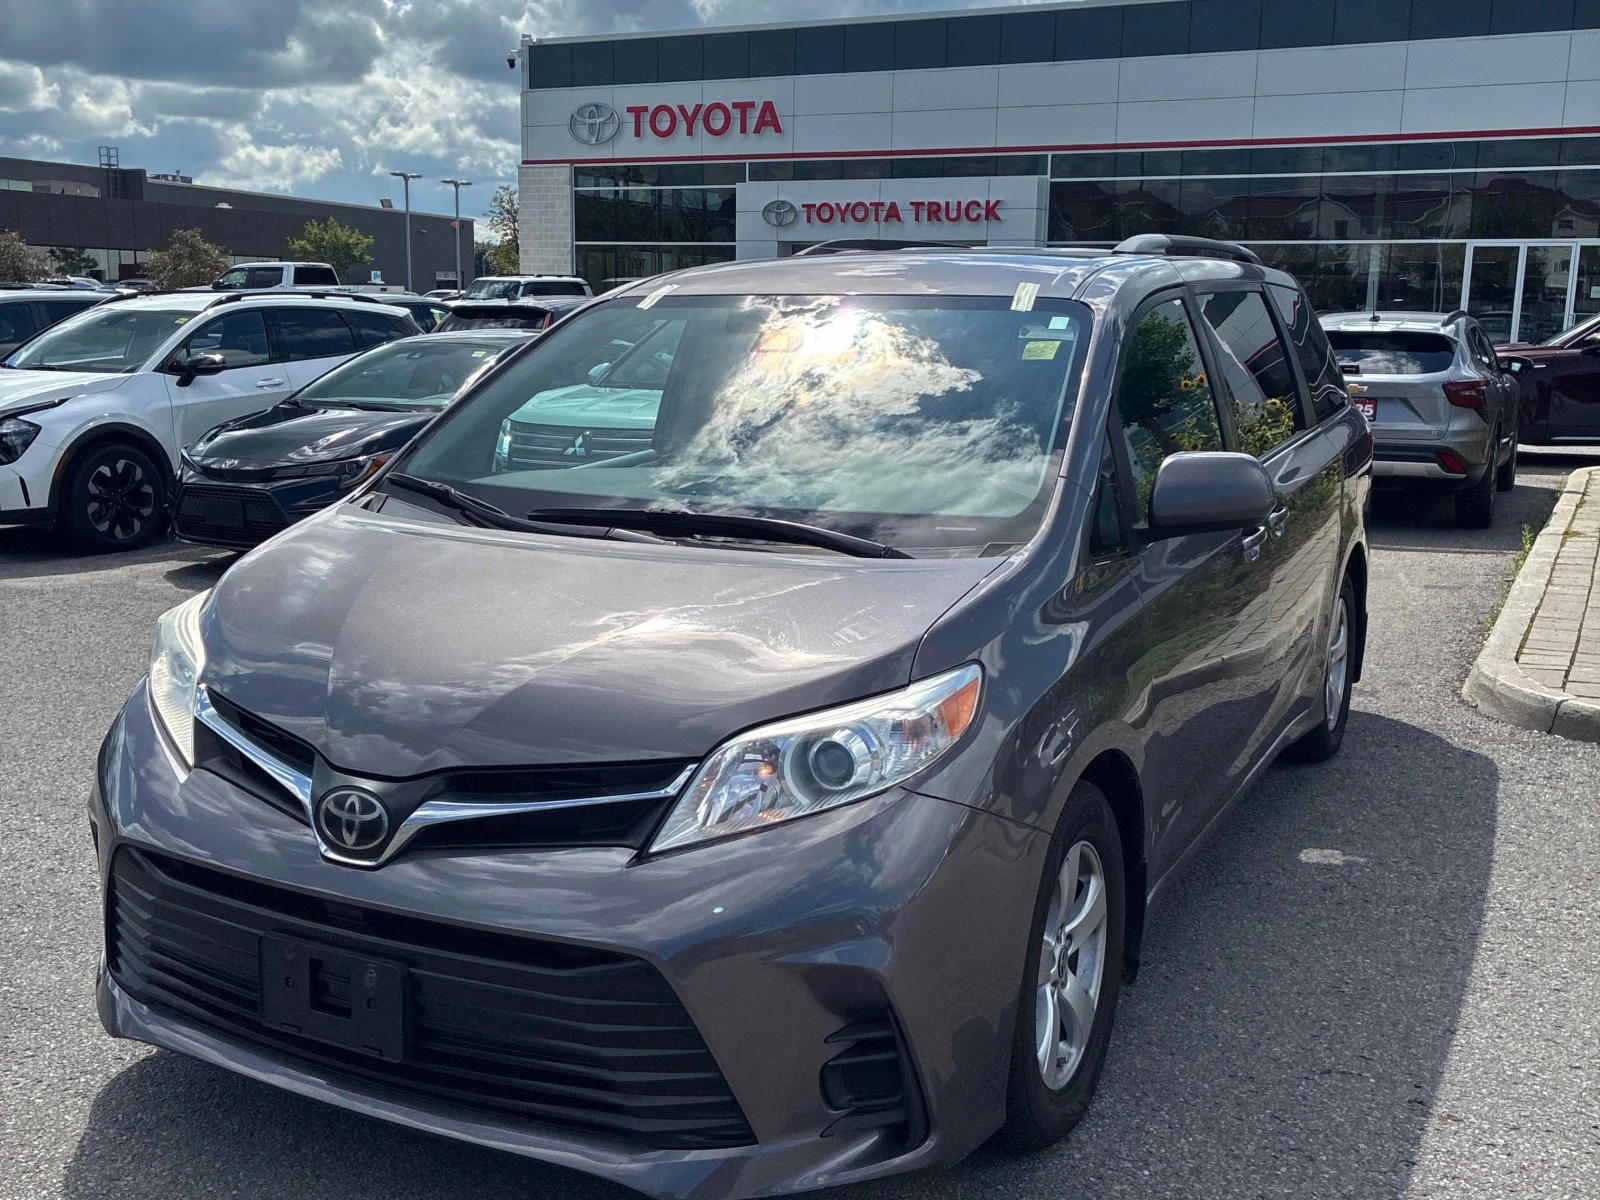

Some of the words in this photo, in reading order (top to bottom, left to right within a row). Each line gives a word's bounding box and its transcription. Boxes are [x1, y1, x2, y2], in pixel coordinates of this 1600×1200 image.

[626, 101, 783, 138] TOYOTA
[801, 201, 903, 223] TOYOTA
[909, 200, 1002, 222] TRUCK
